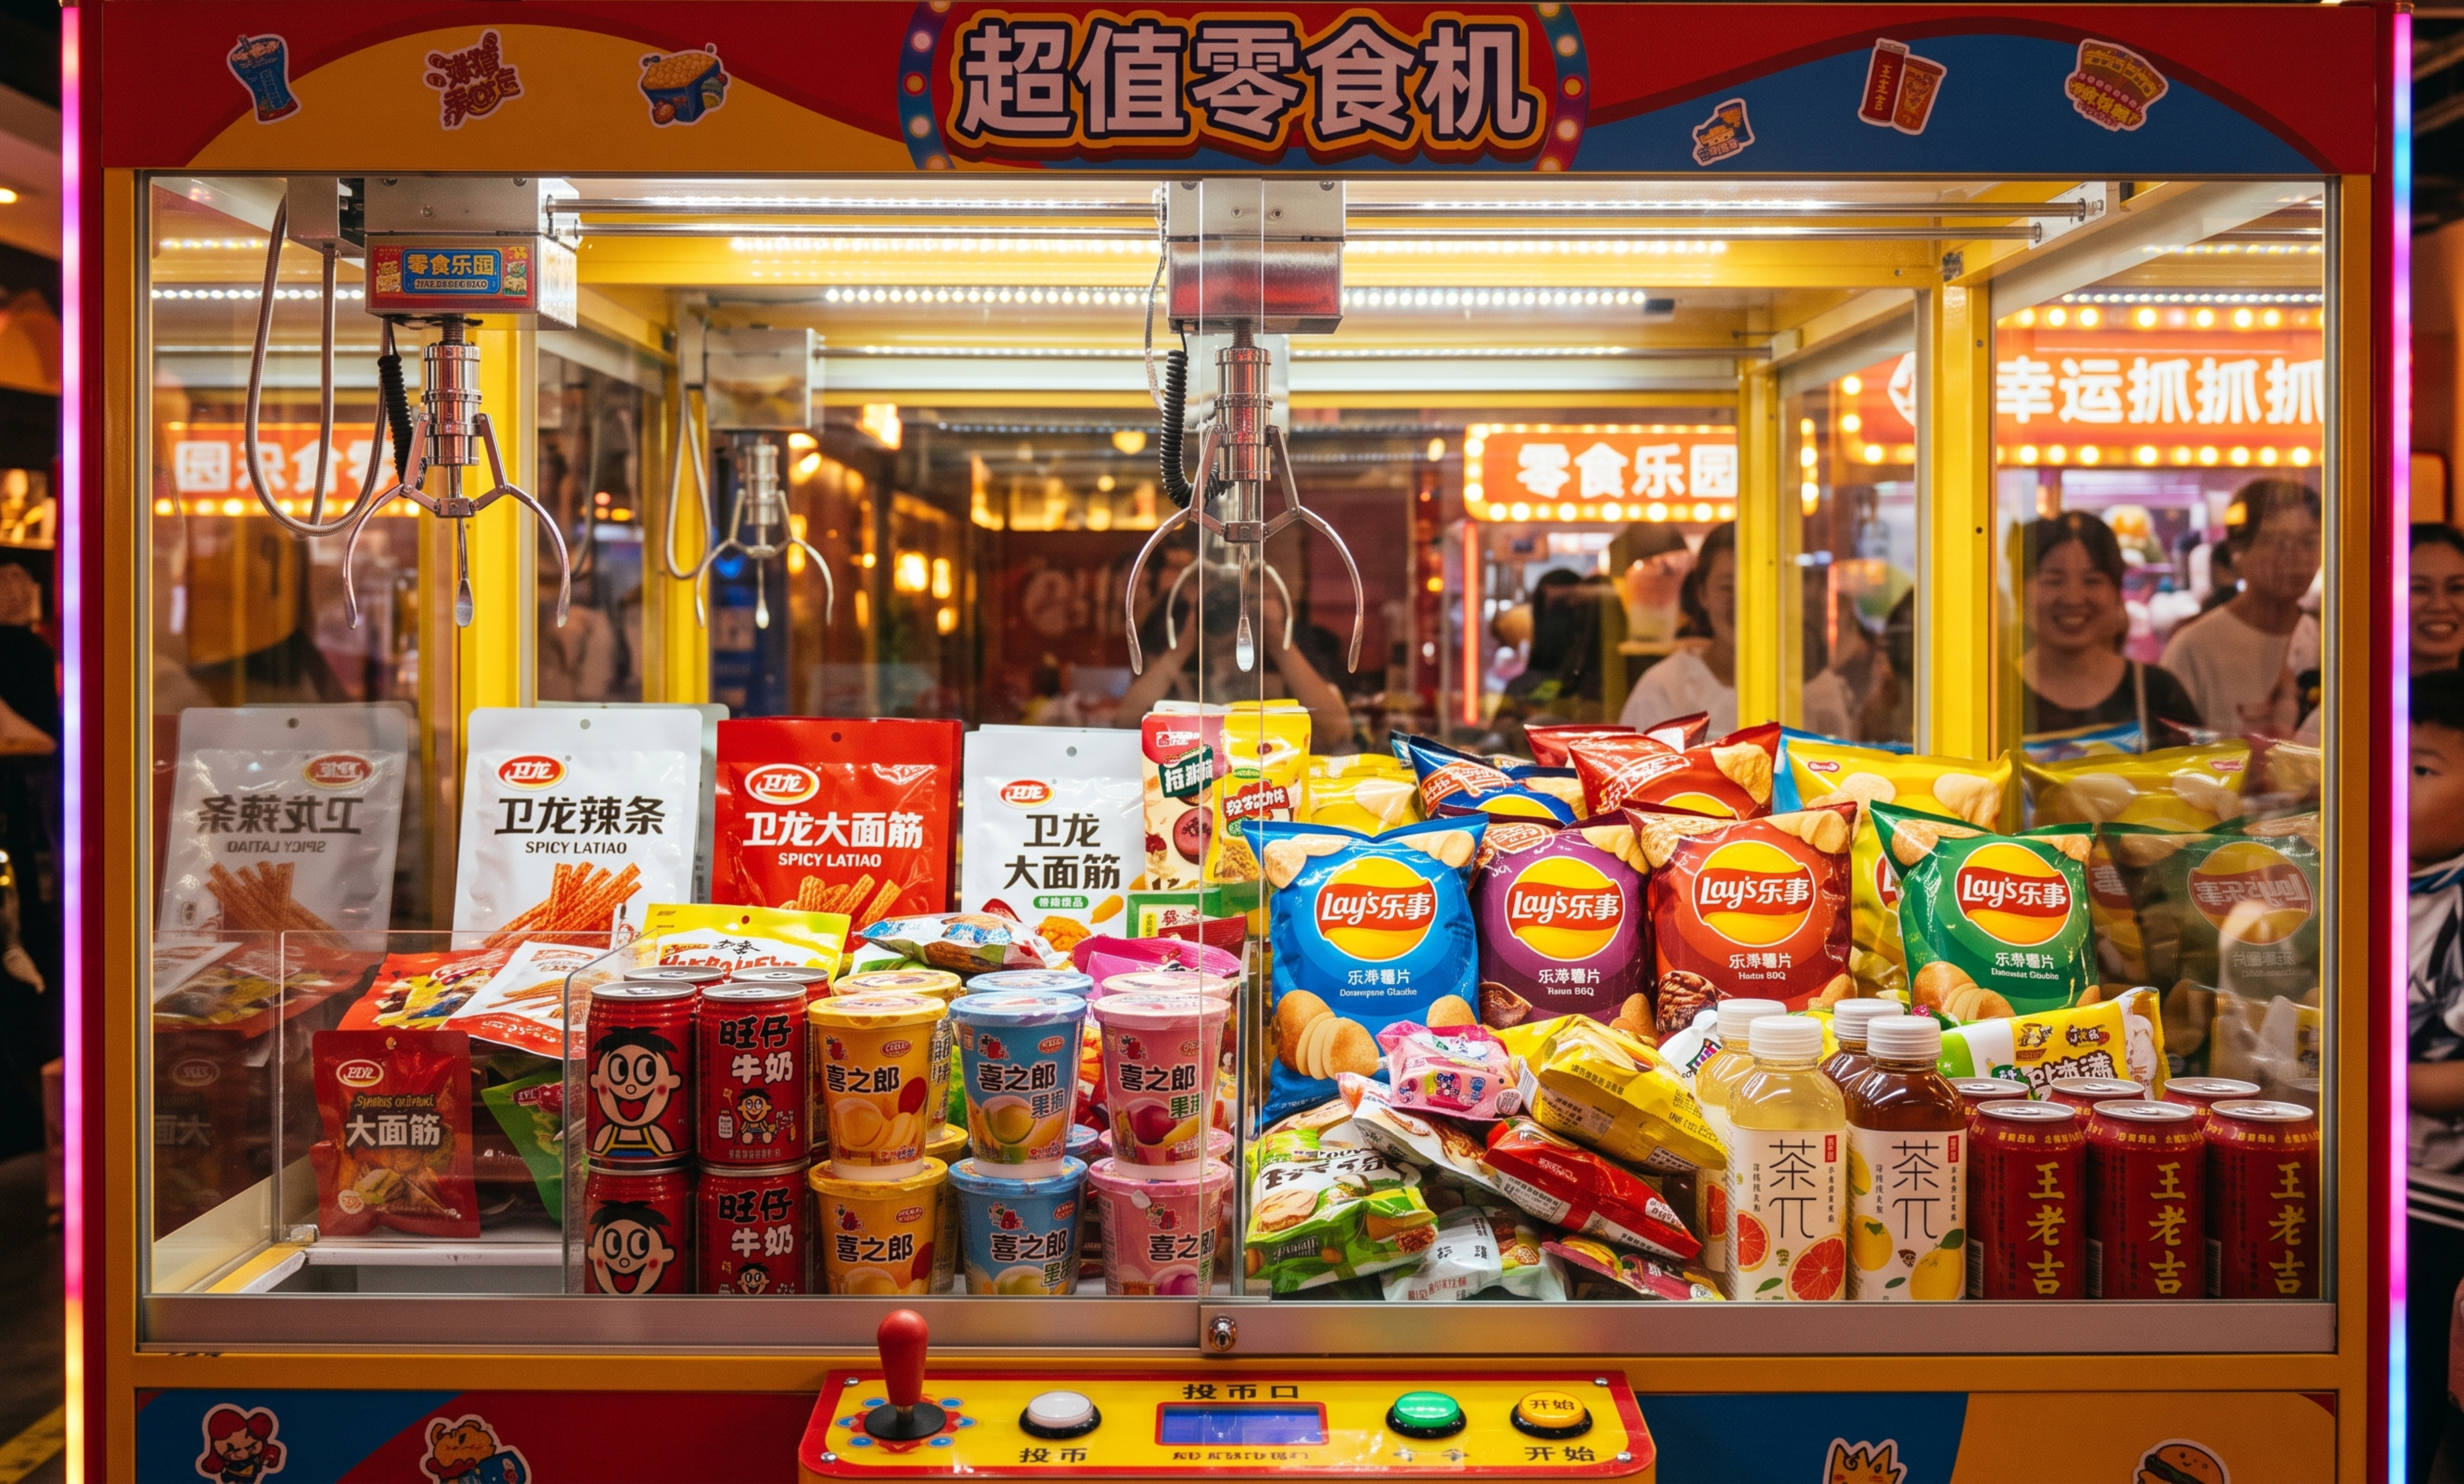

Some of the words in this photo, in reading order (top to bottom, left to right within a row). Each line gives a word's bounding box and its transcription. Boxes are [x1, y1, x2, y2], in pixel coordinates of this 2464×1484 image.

[962, 24, 1532, 136] 超值零食机
[1997, 356, 2323, 423] 幸运抓抓抓
[1516, 442, 1738, 499] 零食乐园
[507, 761, 555, 780] 卫龙
[758, 773, 806, 792] 卫龙
[494, 795, 665, 835] 卫龙辣条
[742, 811, 923, 849] 卫龙大面筋
[1023, 813, 1101, 847] 卫龙
[525, 842, 570, 854] SPICY
[573, 842, 627, 854] LATIAO
[778, 852, 824, 866] SPICY
[827, 853, 882, 867] LATIAO
[1003, 854, 1120, 890] 大面筋
[718, 1015, 793, 1049] 旺仔
[732, 1051, 793, 1083] 牛奶
[826, 1064, 899, 1094] 喜之郎
[978, 1062, 1056, 1092] 喜之郎
[1120, 1064, 1196, 1091] 喜之郎
[346, 1114, 440, 1147] 大面筋
[718, 1187, 793, 1224] 旺仔
[732, 1224, 793, 1258] 牛奶
[990, 1228, 1068, 1262] 喜之郎
[2027, 1162, 2066, 1295] 王老吉
[2148, 1162, 2187, 1295] 王老吉
[2268, 1162, 2306, 1294] 王老吉
[836, 1233, 913, 1262] 喜之郎
[1183, 1384, 1299, 1400] 投币口
[1019, 1447, 1088, 1464] 投币
[1524, 1446, 1595, 1462] 开始
